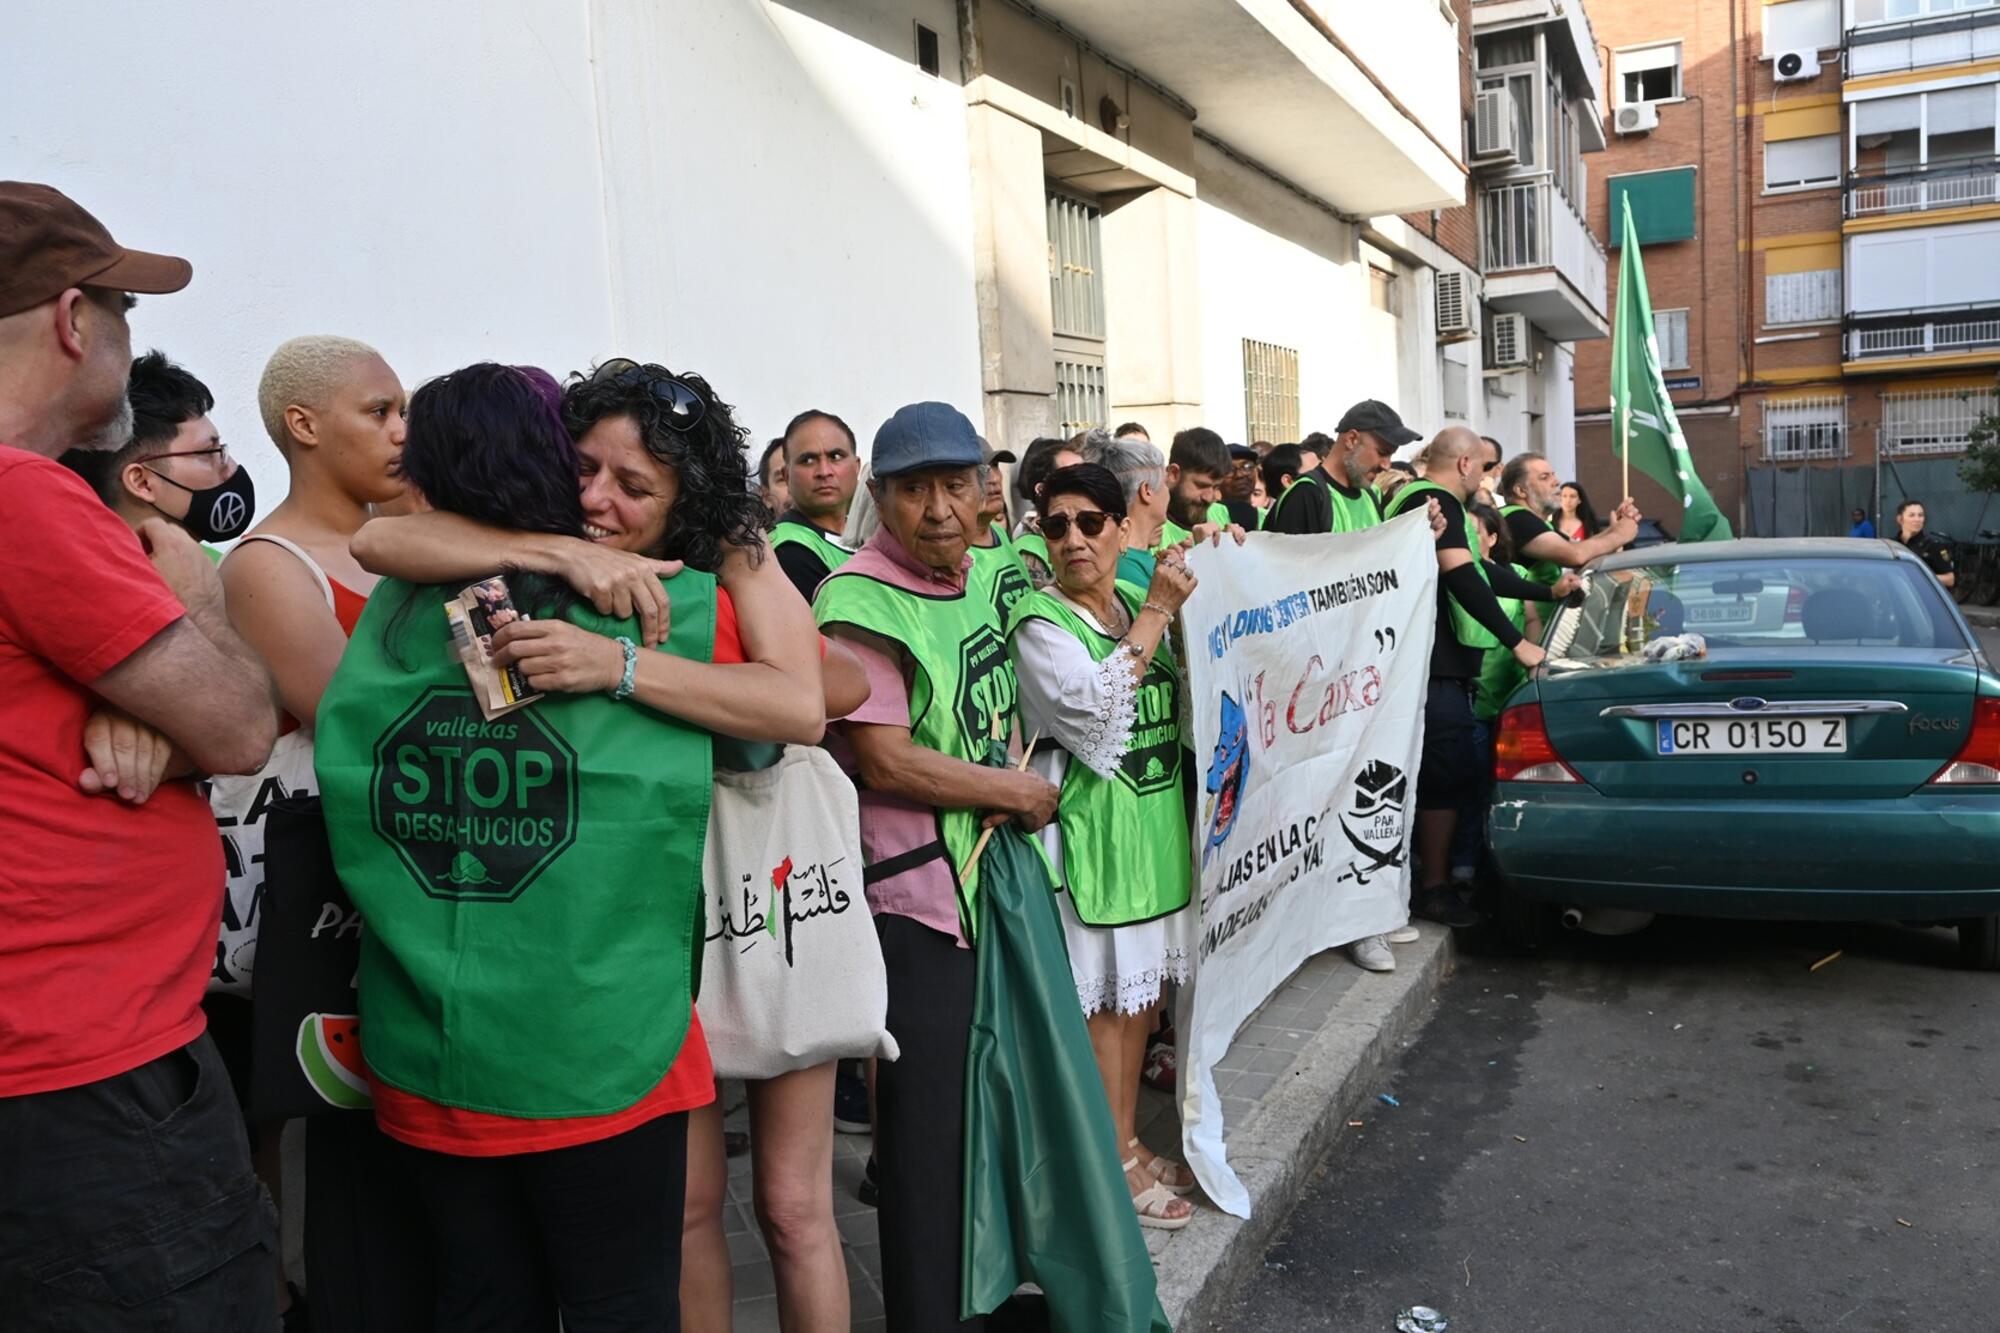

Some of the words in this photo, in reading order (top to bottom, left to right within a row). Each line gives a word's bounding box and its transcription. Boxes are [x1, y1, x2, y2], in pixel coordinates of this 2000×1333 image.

[1308, 575, 1368, 613] TAMBIÉN
[1367, 568, 1399, 597] SON
[1136, 681, 1173, 725] TOP
[426, 716, 518, 740] vallekas
[1124, 723, 1179, 753] ESAHUCIO
[1673, 722, 1710, 749] CR
[1727, 720, 1806, 748] 0150
[1822, 720, 1842, 748] Z
[393, 744, 553, 809] STOP
[395, 812, 554, 848] DESAHUCIOS
[1363, 825, 1403, 841] VALLEKA
[1374, 815, 1394, 828] PAH
[1256, 834, 1278, 874] EN
[1279, 823, 1303, 859] LA
[1303, 837, 1325, 875] YA!
